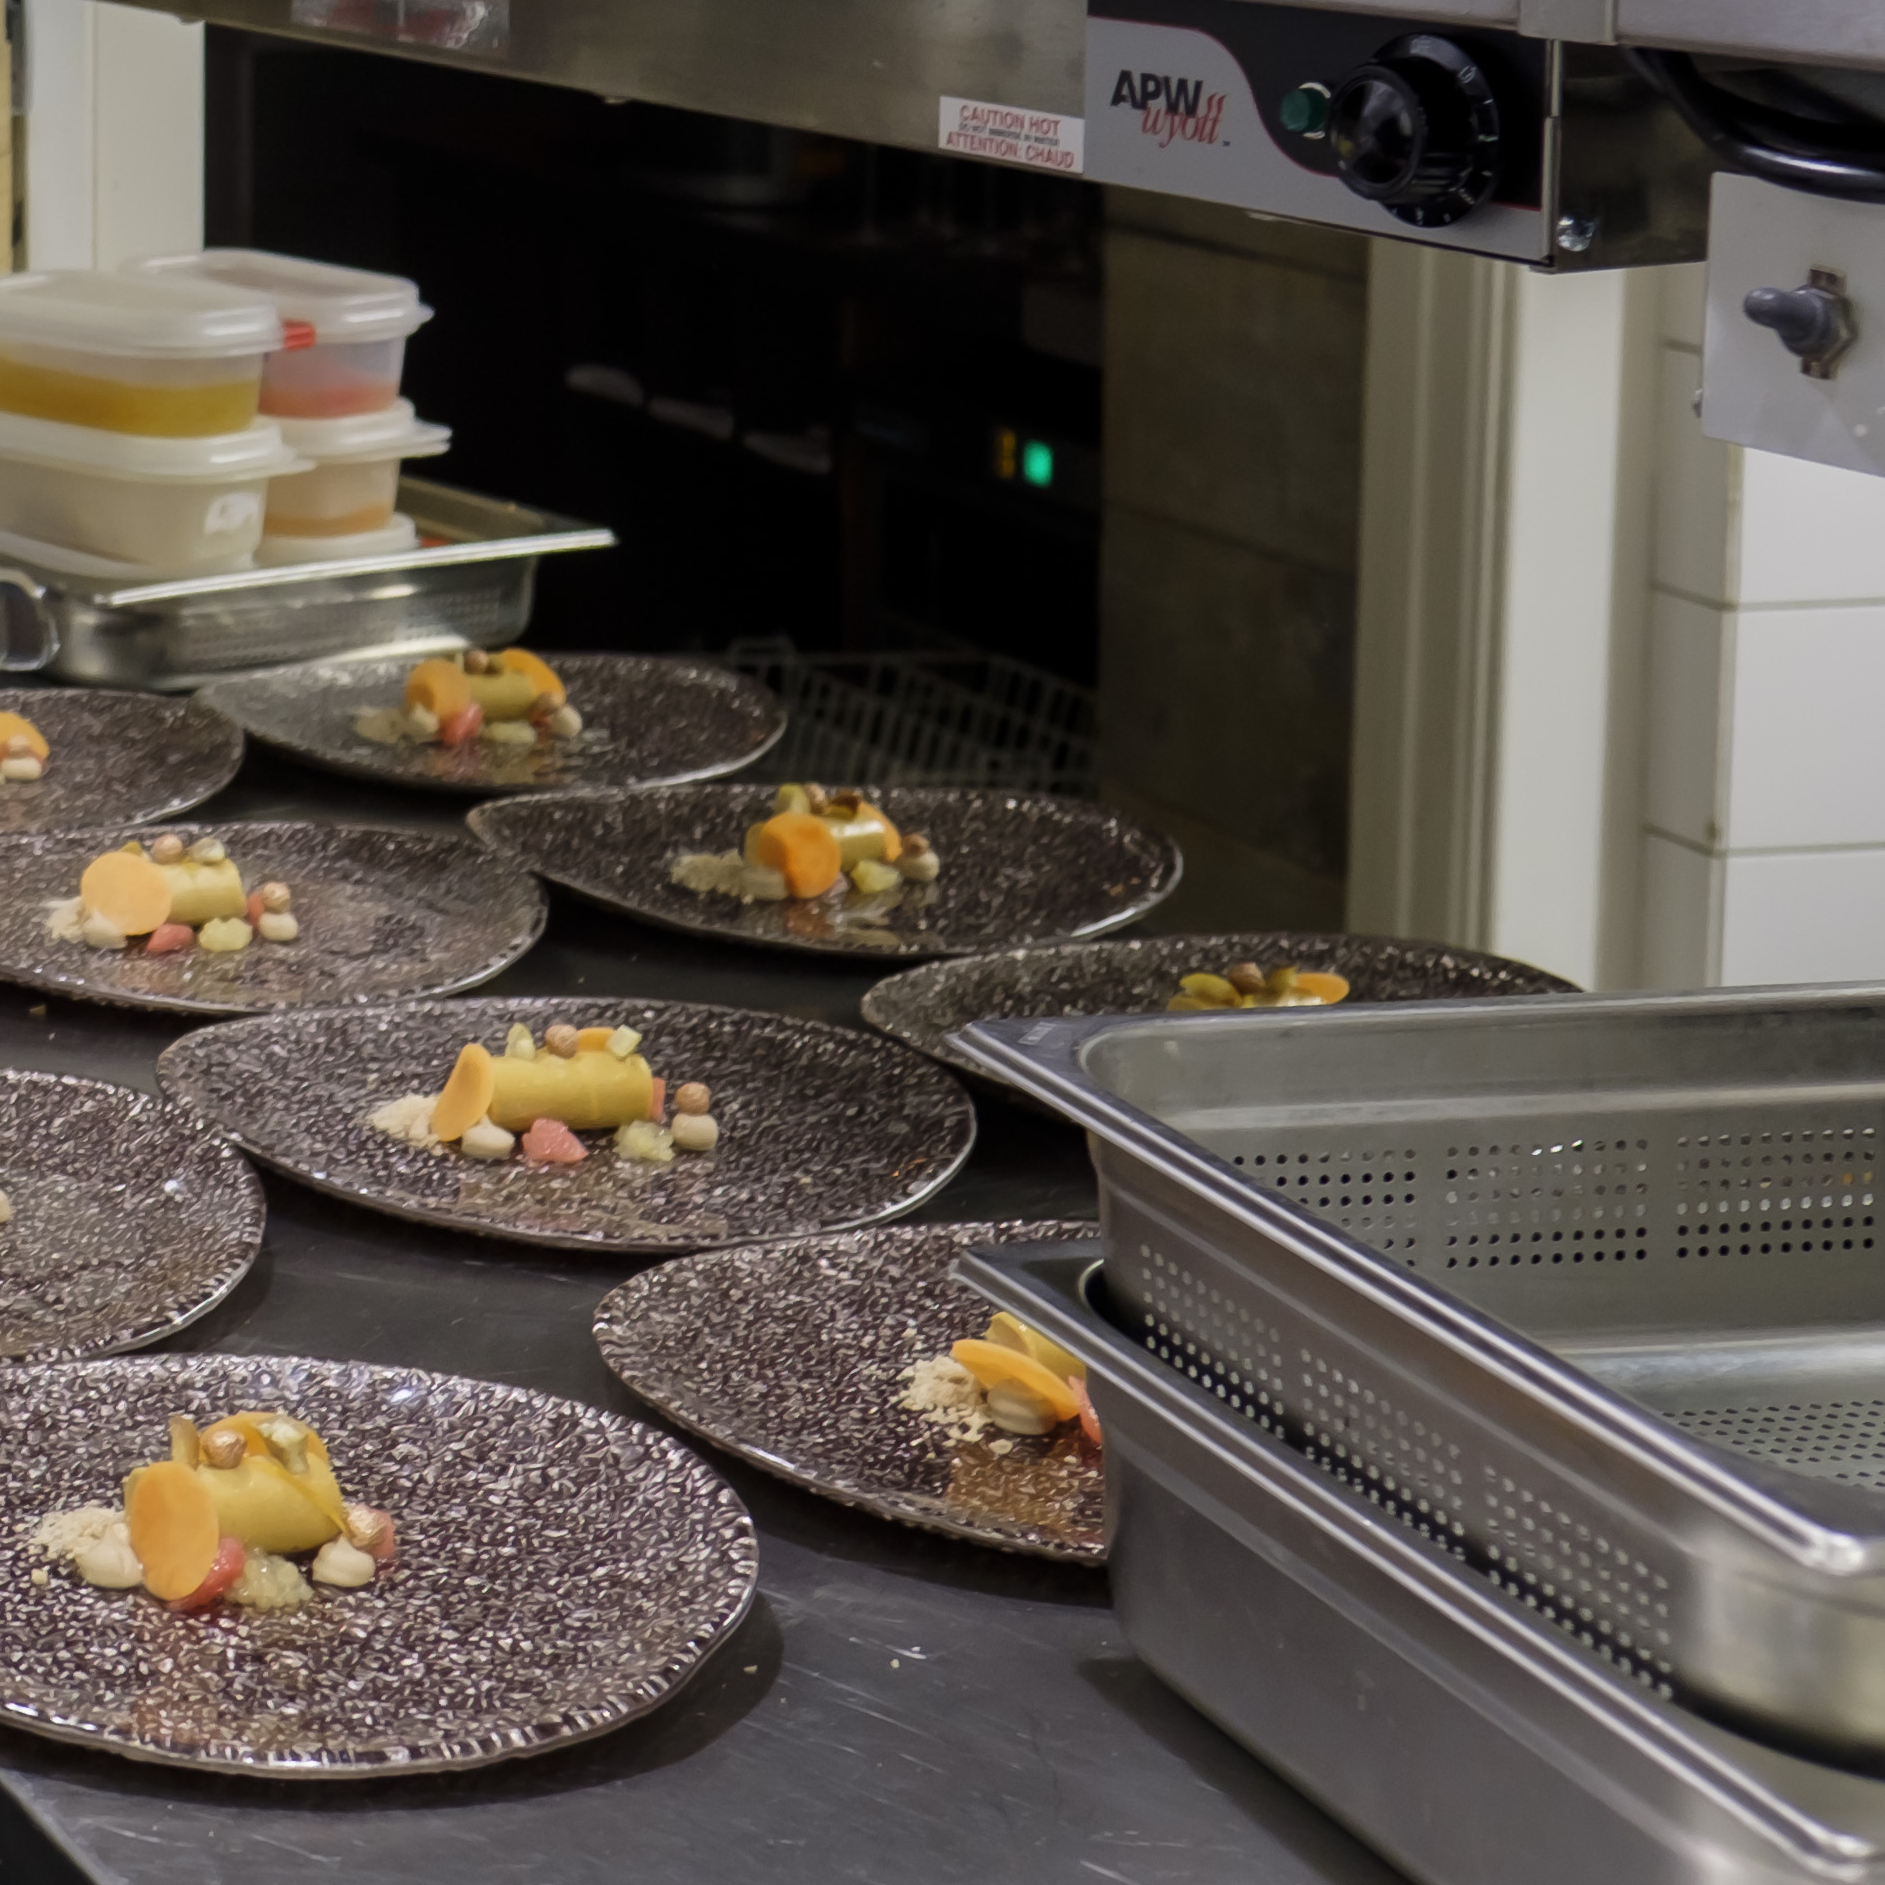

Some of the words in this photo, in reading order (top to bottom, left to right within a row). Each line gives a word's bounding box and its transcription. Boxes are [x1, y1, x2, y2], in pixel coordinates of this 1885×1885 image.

[1110, 69, 1205, 119] APW
[959, 104, 1026, 131] CAUTION
[1028, 116, 1062, 137] HOT
[1024, 143, 1075, 169] CHAUD
